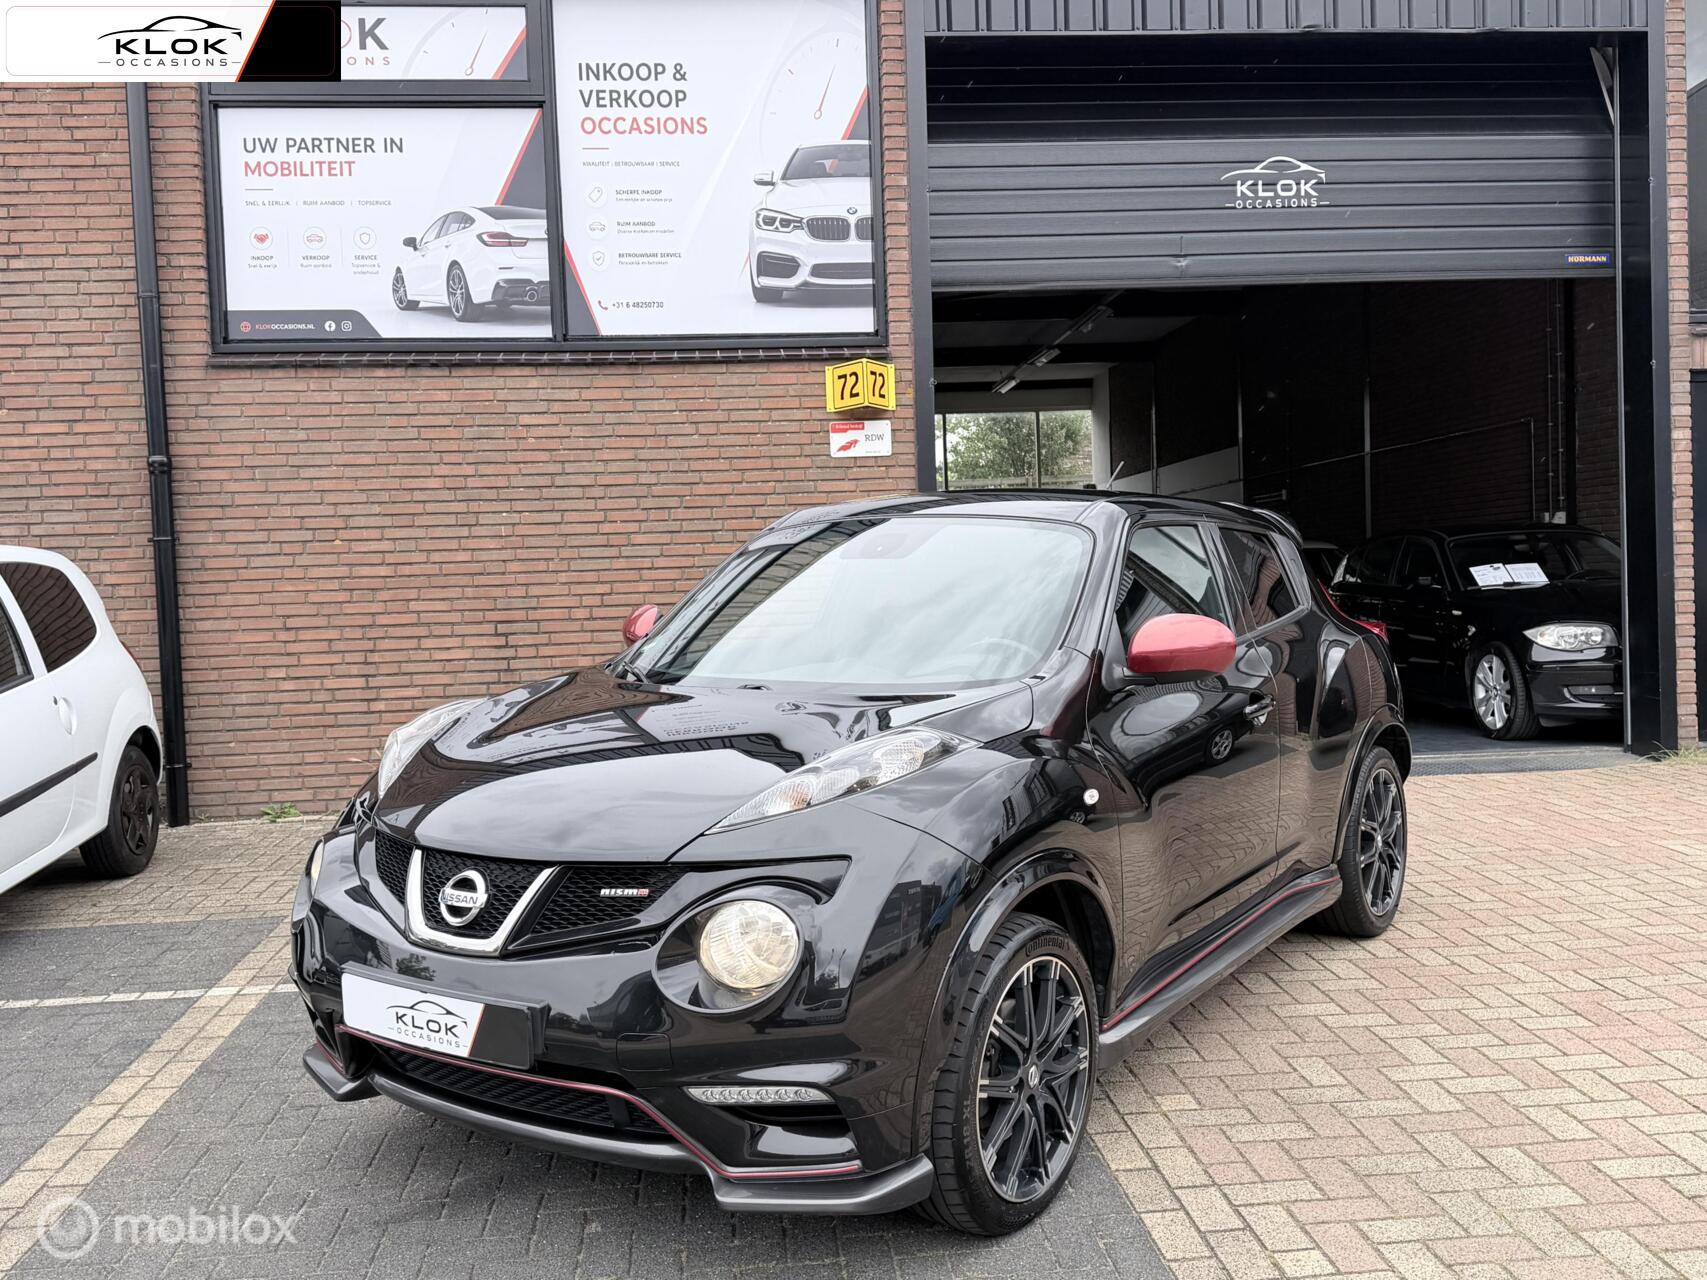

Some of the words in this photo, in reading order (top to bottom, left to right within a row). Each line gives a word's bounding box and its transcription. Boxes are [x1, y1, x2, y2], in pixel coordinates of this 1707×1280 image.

[578, 62, 666, 81] INKOOP
[672, 62, 688, 81] &
[578, 89, 687, 108] VERKOOP
[580, 116, 708, 135] OCCASIONS
[243, 137, 278, 153] UW
[285, 137, 376, 153] PARTNER
[383, 137, 404, 153] IN
[244, 160, 356, 177] MOBILITEIT
[1236, 179, 1319, 197] KLOK
[1235, 198, 1318, 208] OCCASIONS
[837, 371, 860, 401] 72
[869, 370, 886, 399] 72
[864, 433, 885, 442] RDW
[440, 891, 479, 905] NISSAN
[395, 1011, 460, 1039] KLOK
[396, 1027, 461, 1048] OCCASIONS
